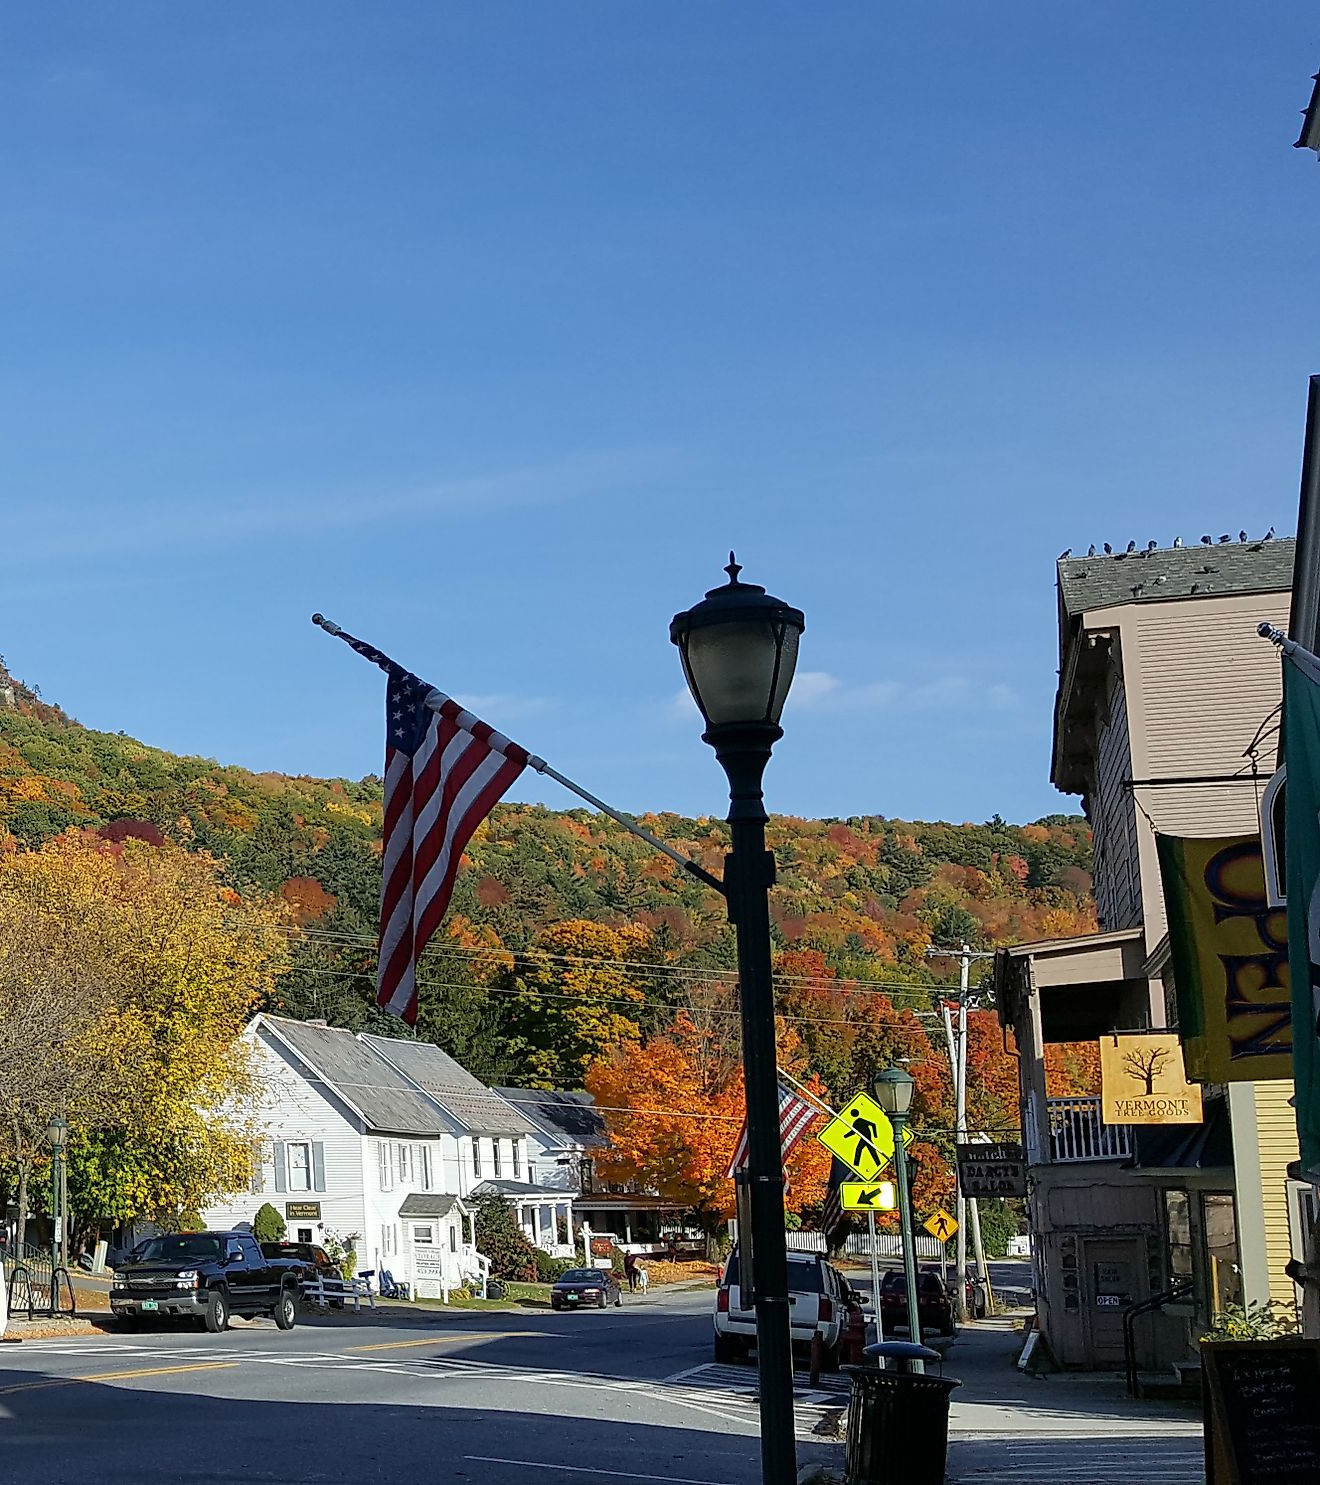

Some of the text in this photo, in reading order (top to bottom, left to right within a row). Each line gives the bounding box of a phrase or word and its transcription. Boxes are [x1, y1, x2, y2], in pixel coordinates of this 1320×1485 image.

[1114, 1099, 1189, 1110] VERMONT
[1115, 1108, 1189, 1117] TREE GOODS
[1098, 1297, 1117, 1305] OPEN
